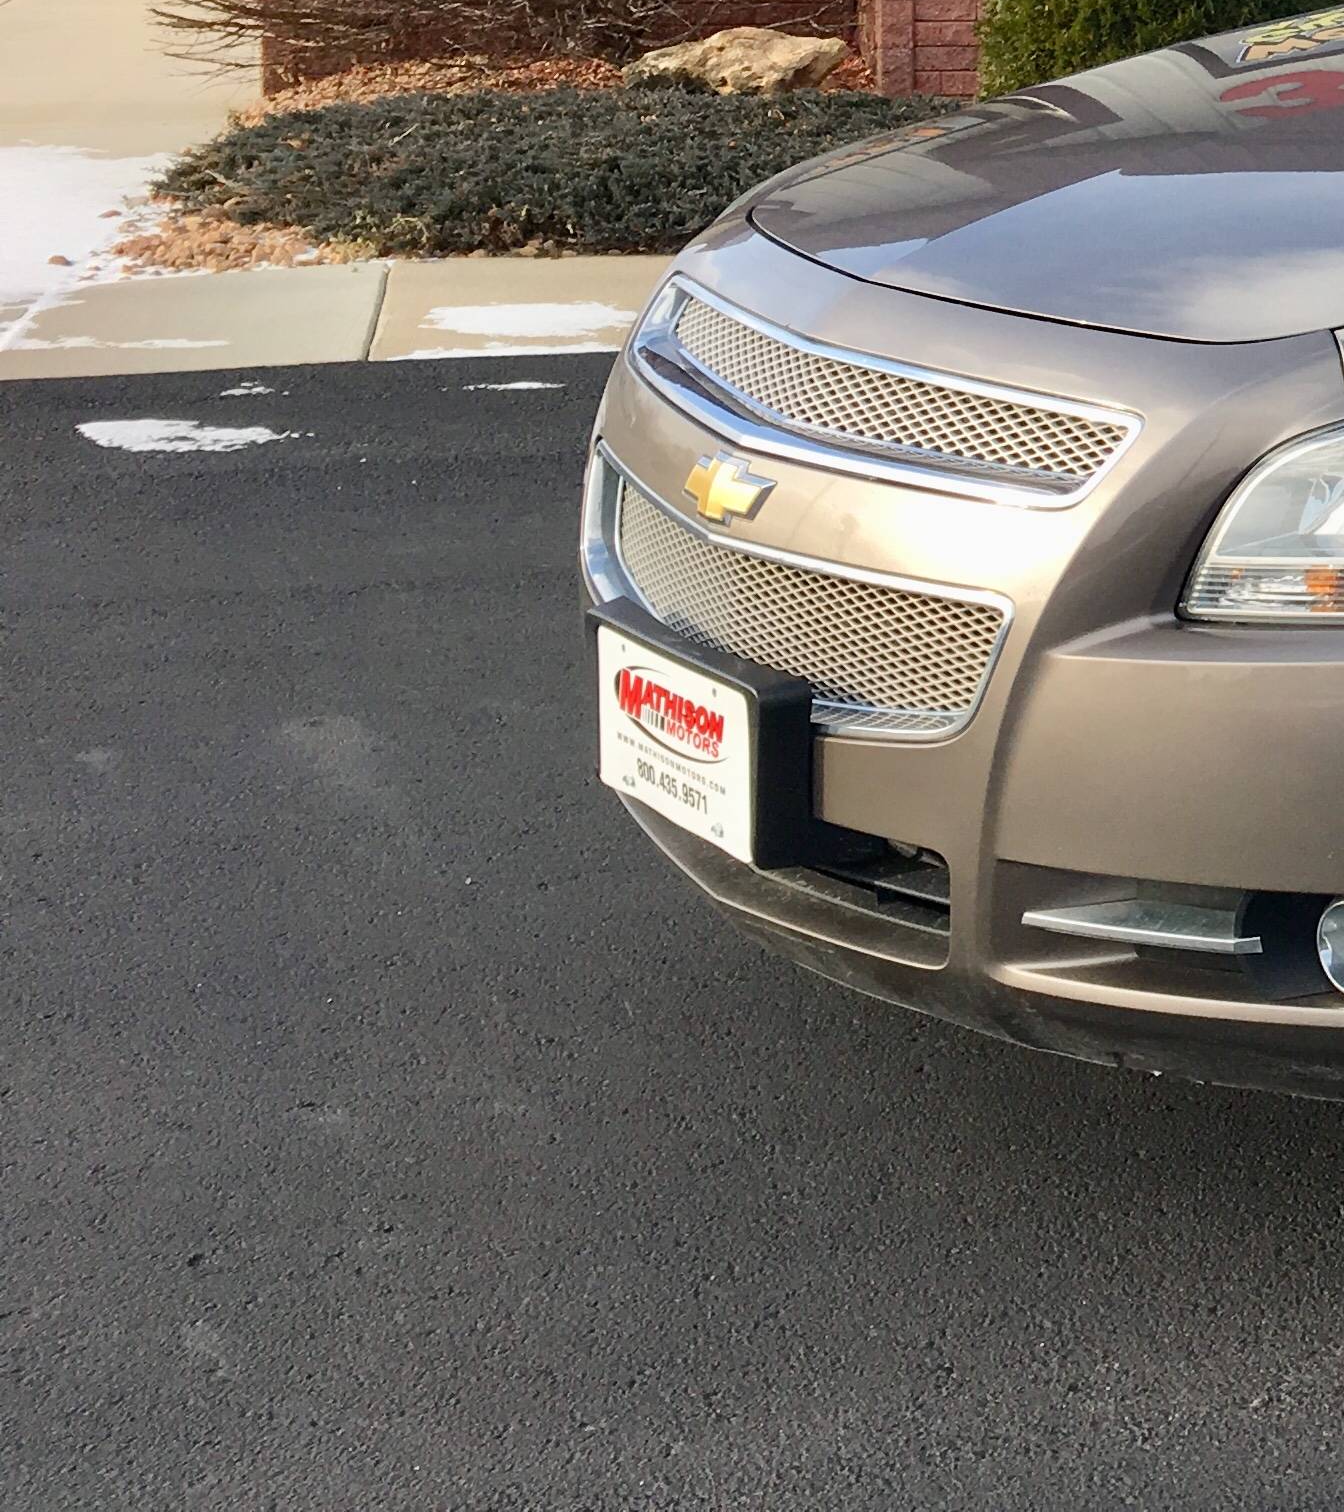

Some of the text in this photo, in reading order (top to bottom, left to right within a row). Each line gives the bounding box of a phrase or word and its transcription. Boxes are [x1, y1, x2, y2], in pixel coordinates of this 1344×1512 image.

[619, 668, 725, 743] MATHISON
[666, 719, 720, 758] MOTORS
[636, 757, 709, 815] 800.435.9571
